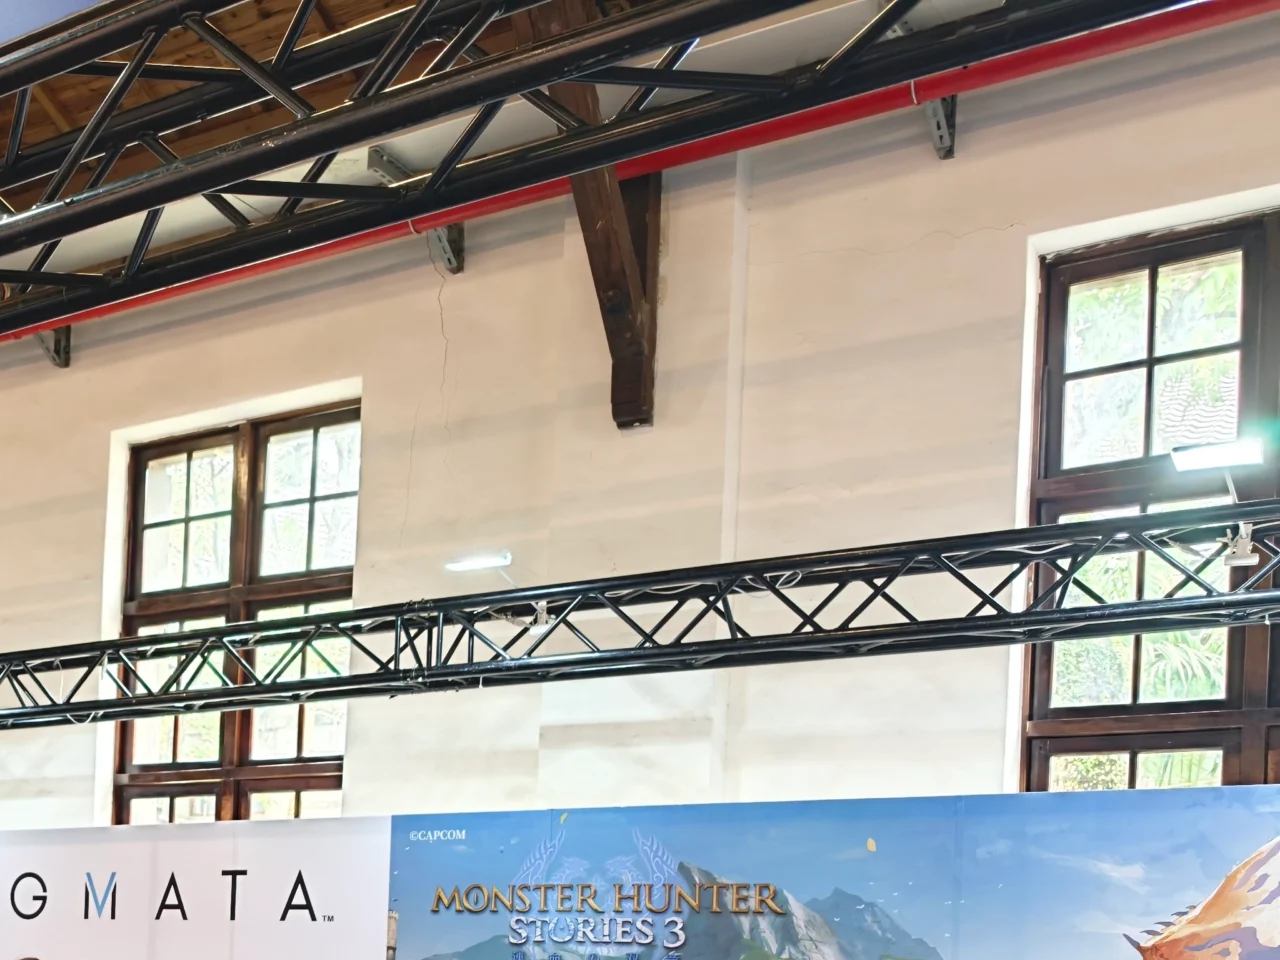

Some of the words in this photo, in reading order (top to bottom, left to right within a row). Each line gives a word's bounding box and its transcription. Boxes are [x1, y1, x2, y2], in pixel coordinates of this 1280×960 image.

[409, 829, 466, 841] ©CAPCOM
[431, 883, 605, 914] MONSTER
[613, 883, 787, 915] HUNTER
[508, 915, 654, 945] STORIES
[663, 916, 687, 948] 3
